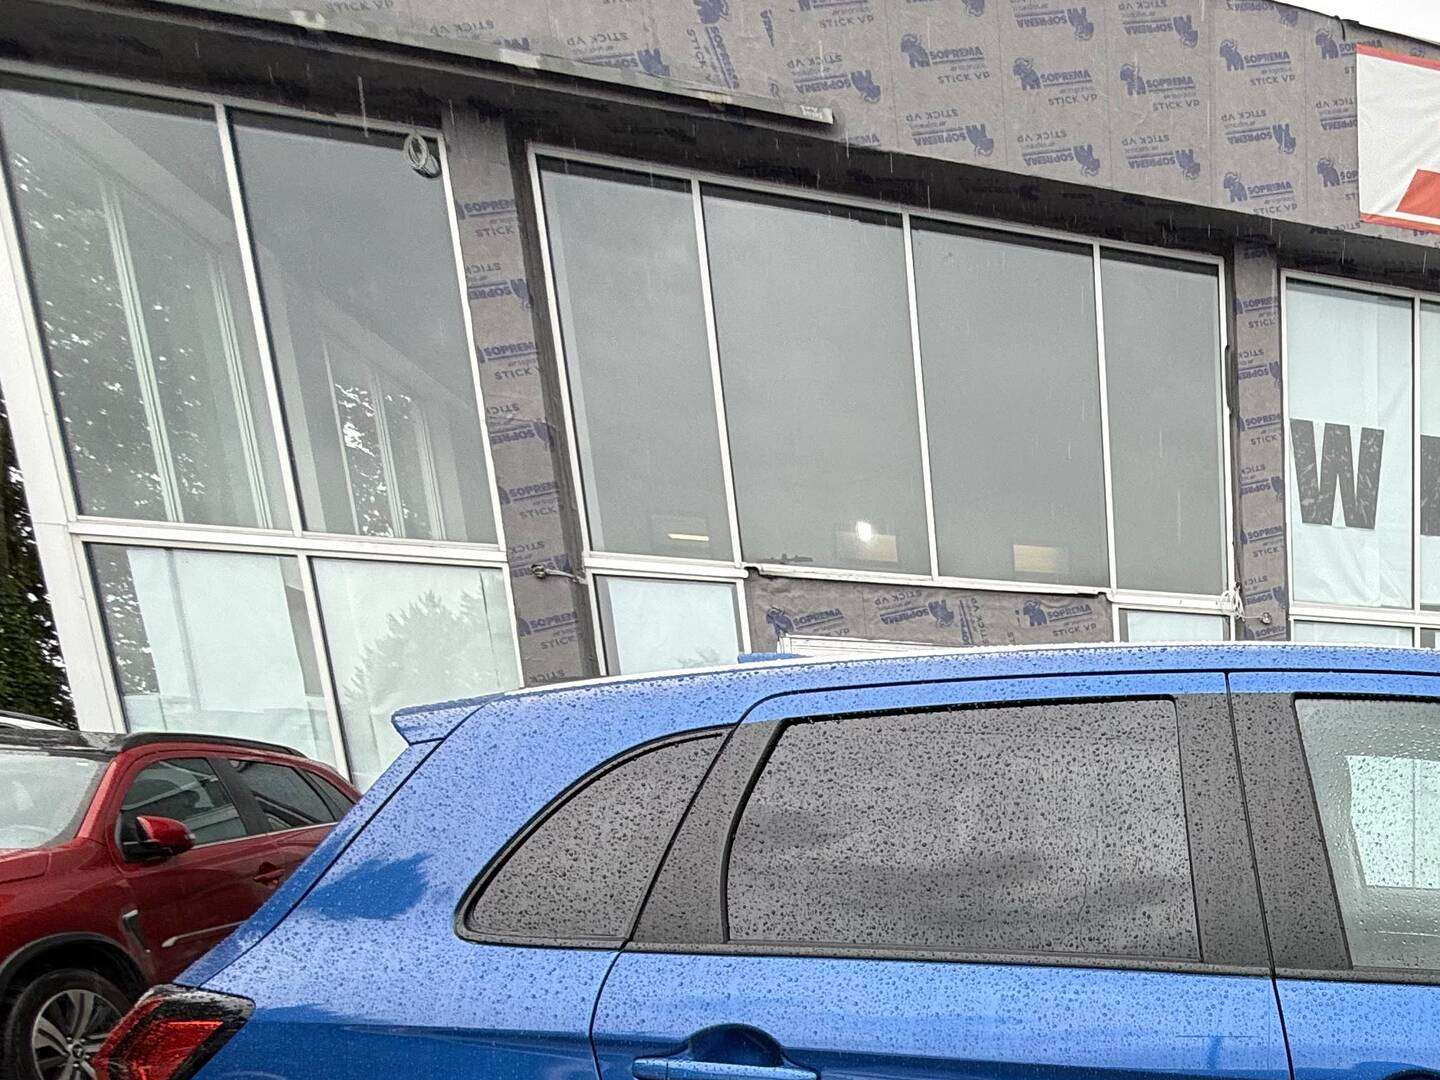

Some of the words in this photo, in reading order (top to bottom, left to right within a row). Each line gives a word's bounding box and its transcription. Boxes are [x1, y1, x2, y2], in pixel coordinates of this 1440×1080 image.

[1016, 16, 1067, 28] SOPREMA
[1124, 23, 1174, 35] SOPREMA
[1338, 40, 1383, 52] SOPMA
[929, 46, 984, 60] SOPREMA
[1244, 51, 1290, 64] SOPREMA
[1040, 69, 1091, 83] SOPREMA
[1147, 76, 1194, 89] SOPREMA
[795, 80, 850, 95] SOPREMA
[1333, 97, 1356, 106] TICK
[913, 132, 966, 146] SOPREMA
[1227, 131, 1273, 144] SOPREMA
[1024, 153, 1074, 166] SOPREMA
[1128, 157, 1176, 169] SOPREMA
[1247, 181, 1292, 194] SOPREMA
[469, 288, 512, 300] SOPRE
[1239, 369, 1269, 379] SOPRE
[486, 403, 520, 415] STIC
[489, 429, 535, 445] SOPRE
[794, 609, 843, 627] SOPREMA
[879, 608, 929, 625] SOPREMA
[1046, 604, 1092, 620] SOPREMA
